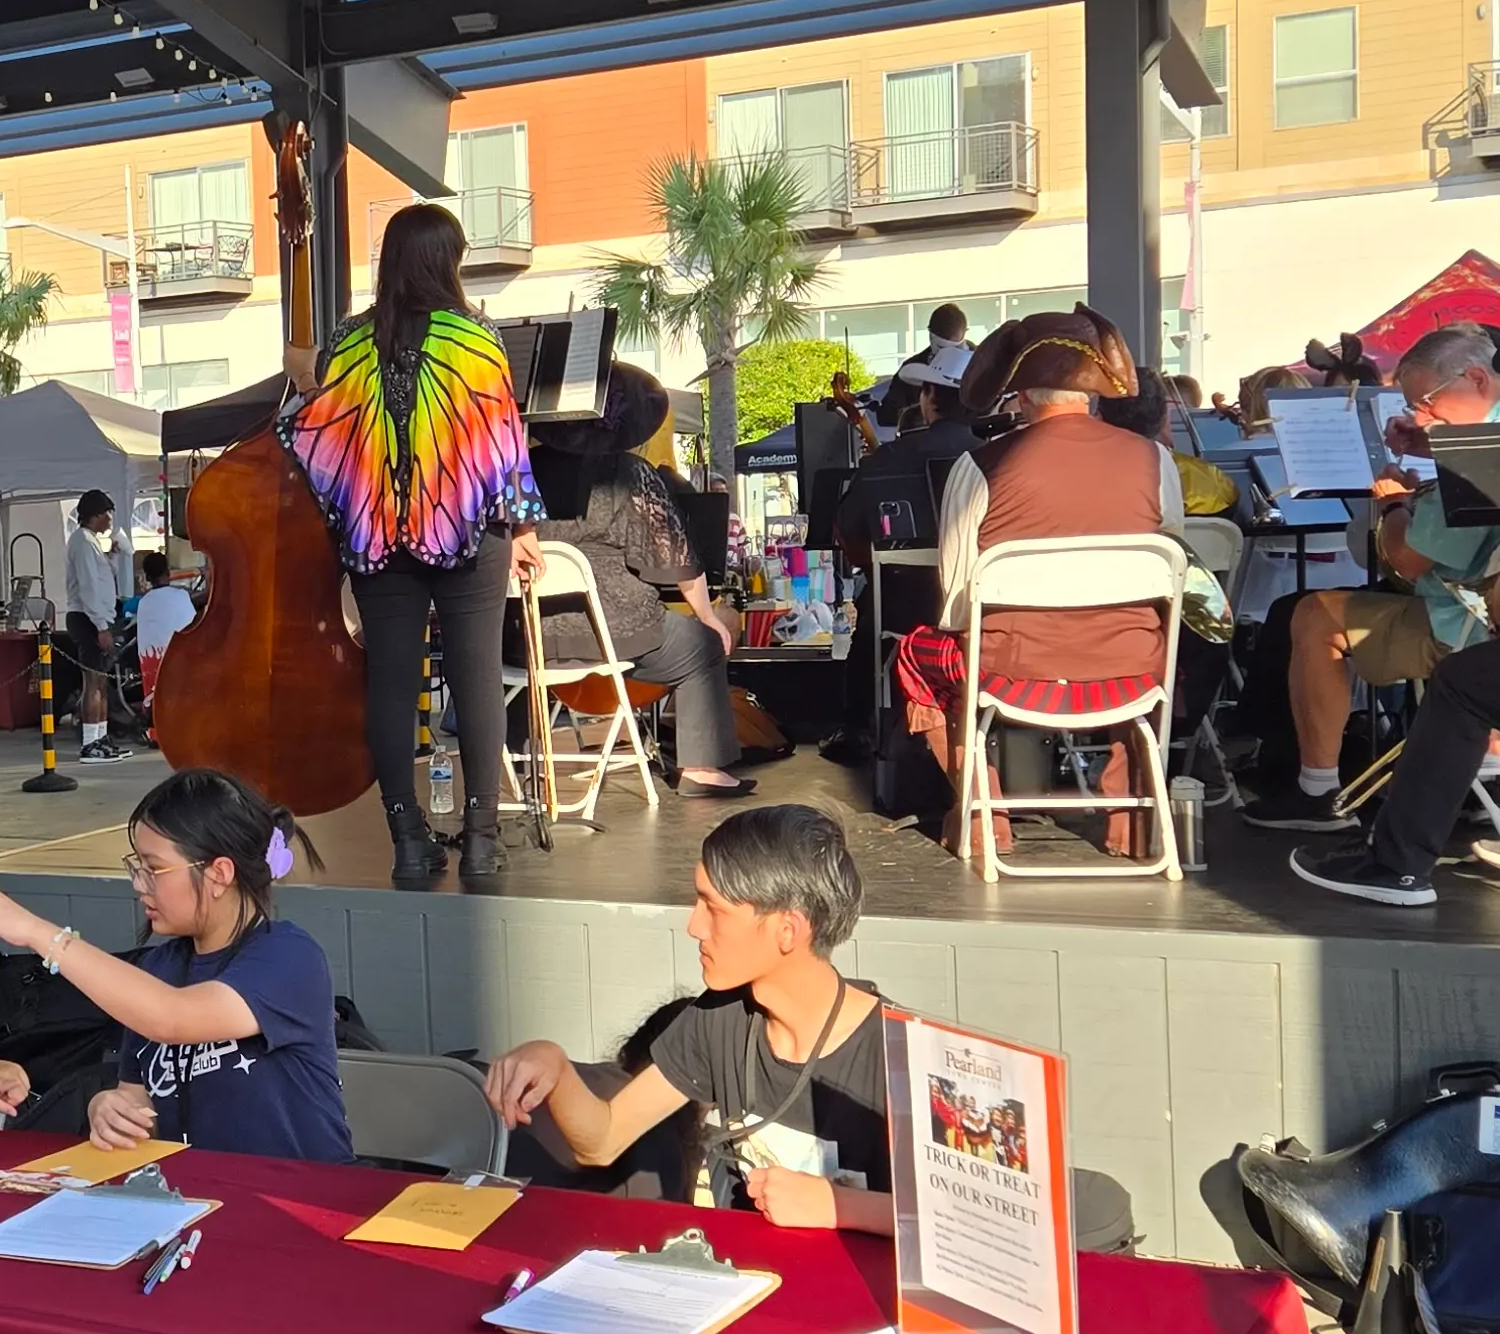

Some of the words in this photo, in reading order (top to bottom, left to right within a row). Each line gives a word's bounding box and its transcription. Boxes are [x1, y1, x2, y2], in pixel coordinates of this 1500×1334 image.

[945, 1050, 1002, 1082] Pearland
[924, 1144, 967, 1173] TRICK
[969, 1162, 990, 1182] OR
[992, 1169, 1041, 1199] TREAT
[930, 1173, 949, 1191] ON
[952, 1182, 982, 1206] OUR
[984, 1194, 1039, 1226] STREET
